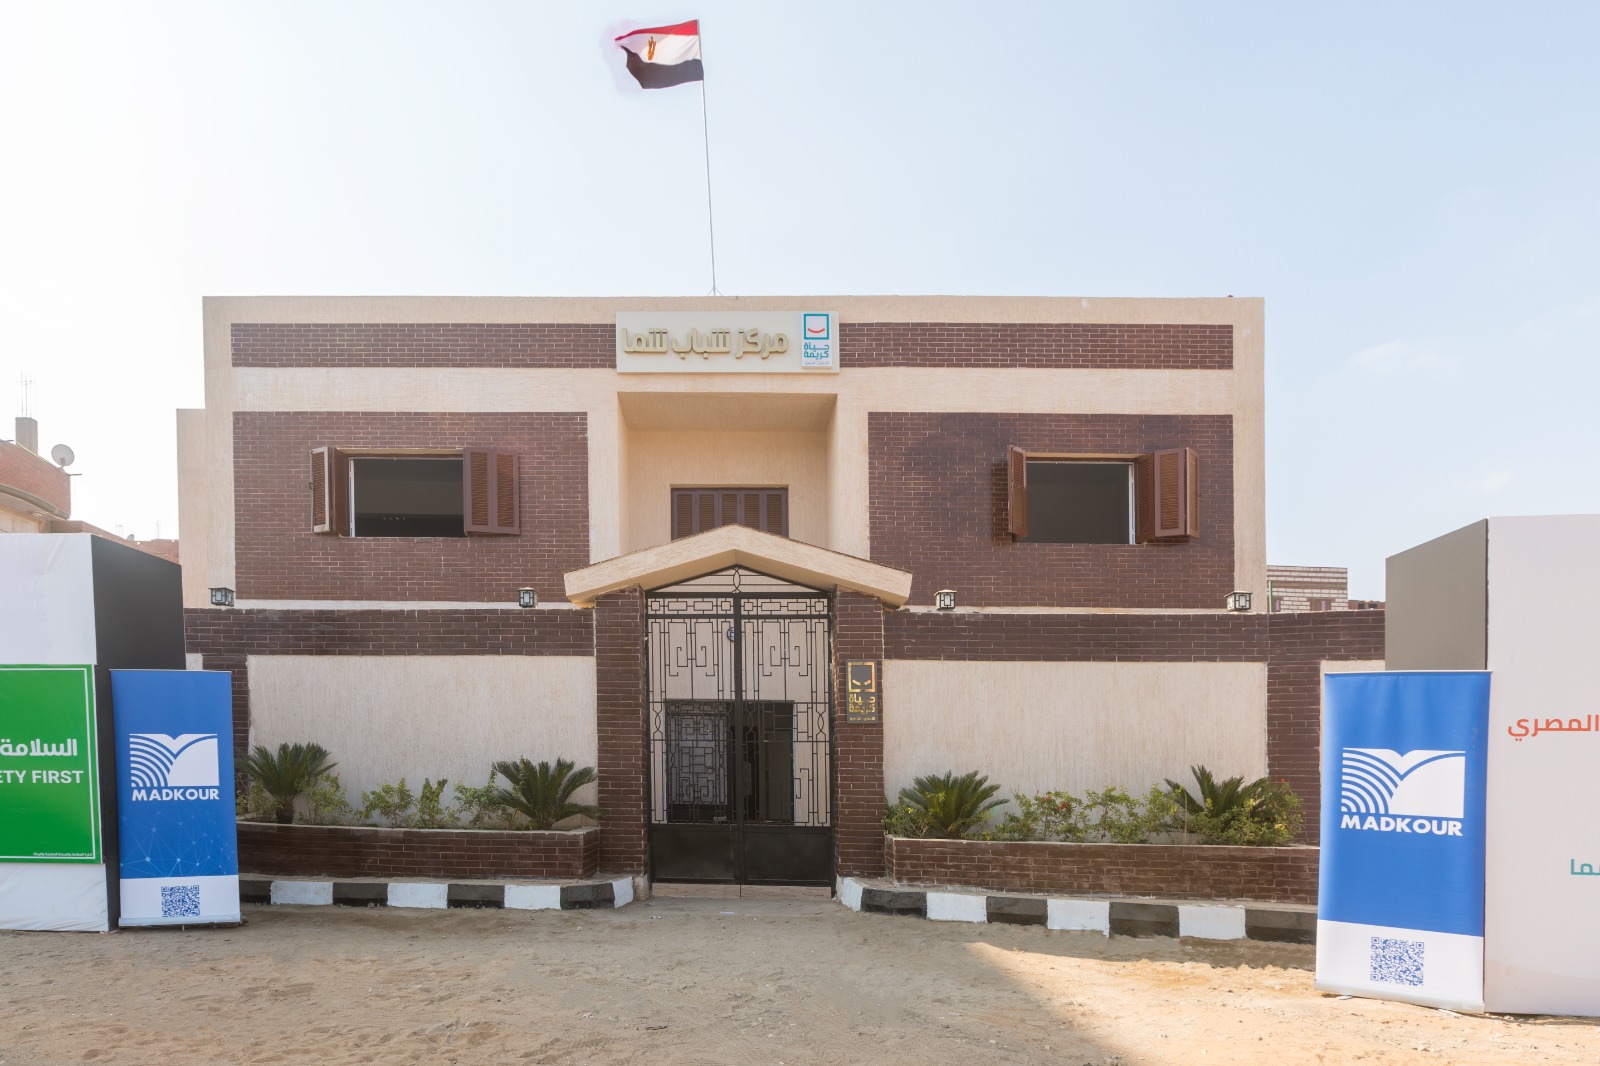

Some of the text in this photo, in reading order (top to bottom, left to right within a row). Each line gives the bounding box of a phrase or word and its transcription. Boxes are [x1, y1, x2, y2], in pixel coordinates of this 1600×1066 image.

[672, 327, 730, 360] شباب
[735, 327, 788, 360] مركز
[803, 341, 830, 352] حياة
[803, 350, 829, 360] كريمة
[1507, 714, 1600, 742] المصري
[0, 738, 78, 756] السلامة
[32, 770, 84, 784] FIRST
[131, 788, 220, 801] MADKOUR
[1341, 814, 1463, 836] MADKOUR
[1570, 858, 1600, 876] ما
